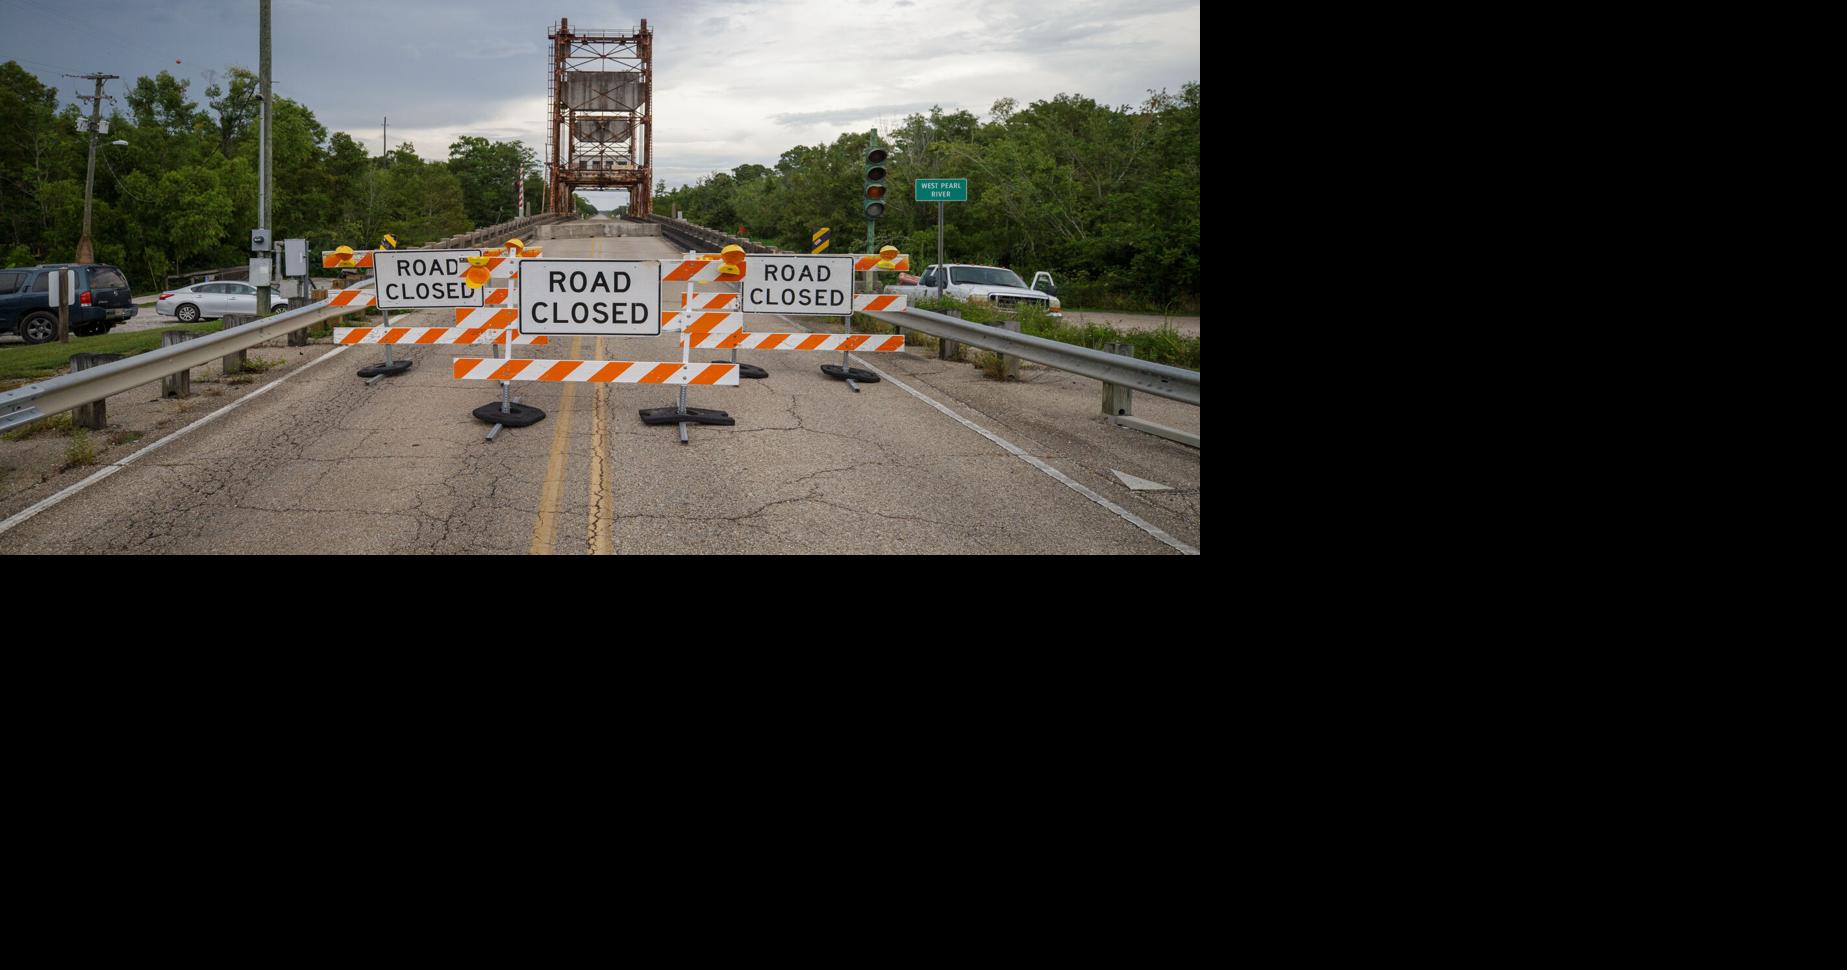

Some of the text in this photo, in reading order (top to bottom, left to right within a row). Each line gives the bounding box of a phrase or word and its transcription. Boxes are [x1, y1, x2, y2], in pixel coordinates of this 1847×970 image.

[931, 190, 951, 198] RIVER
[397, 259, 458, 276] ROAD
[764, 264, 831, 282] ROAD
[386, 282, 475, 300] CLOSED
[549, 271, 631, 293] ROAD
[750, 288, 844, 306] CLOSED
[531, 302, 648, 324] CLOSED
